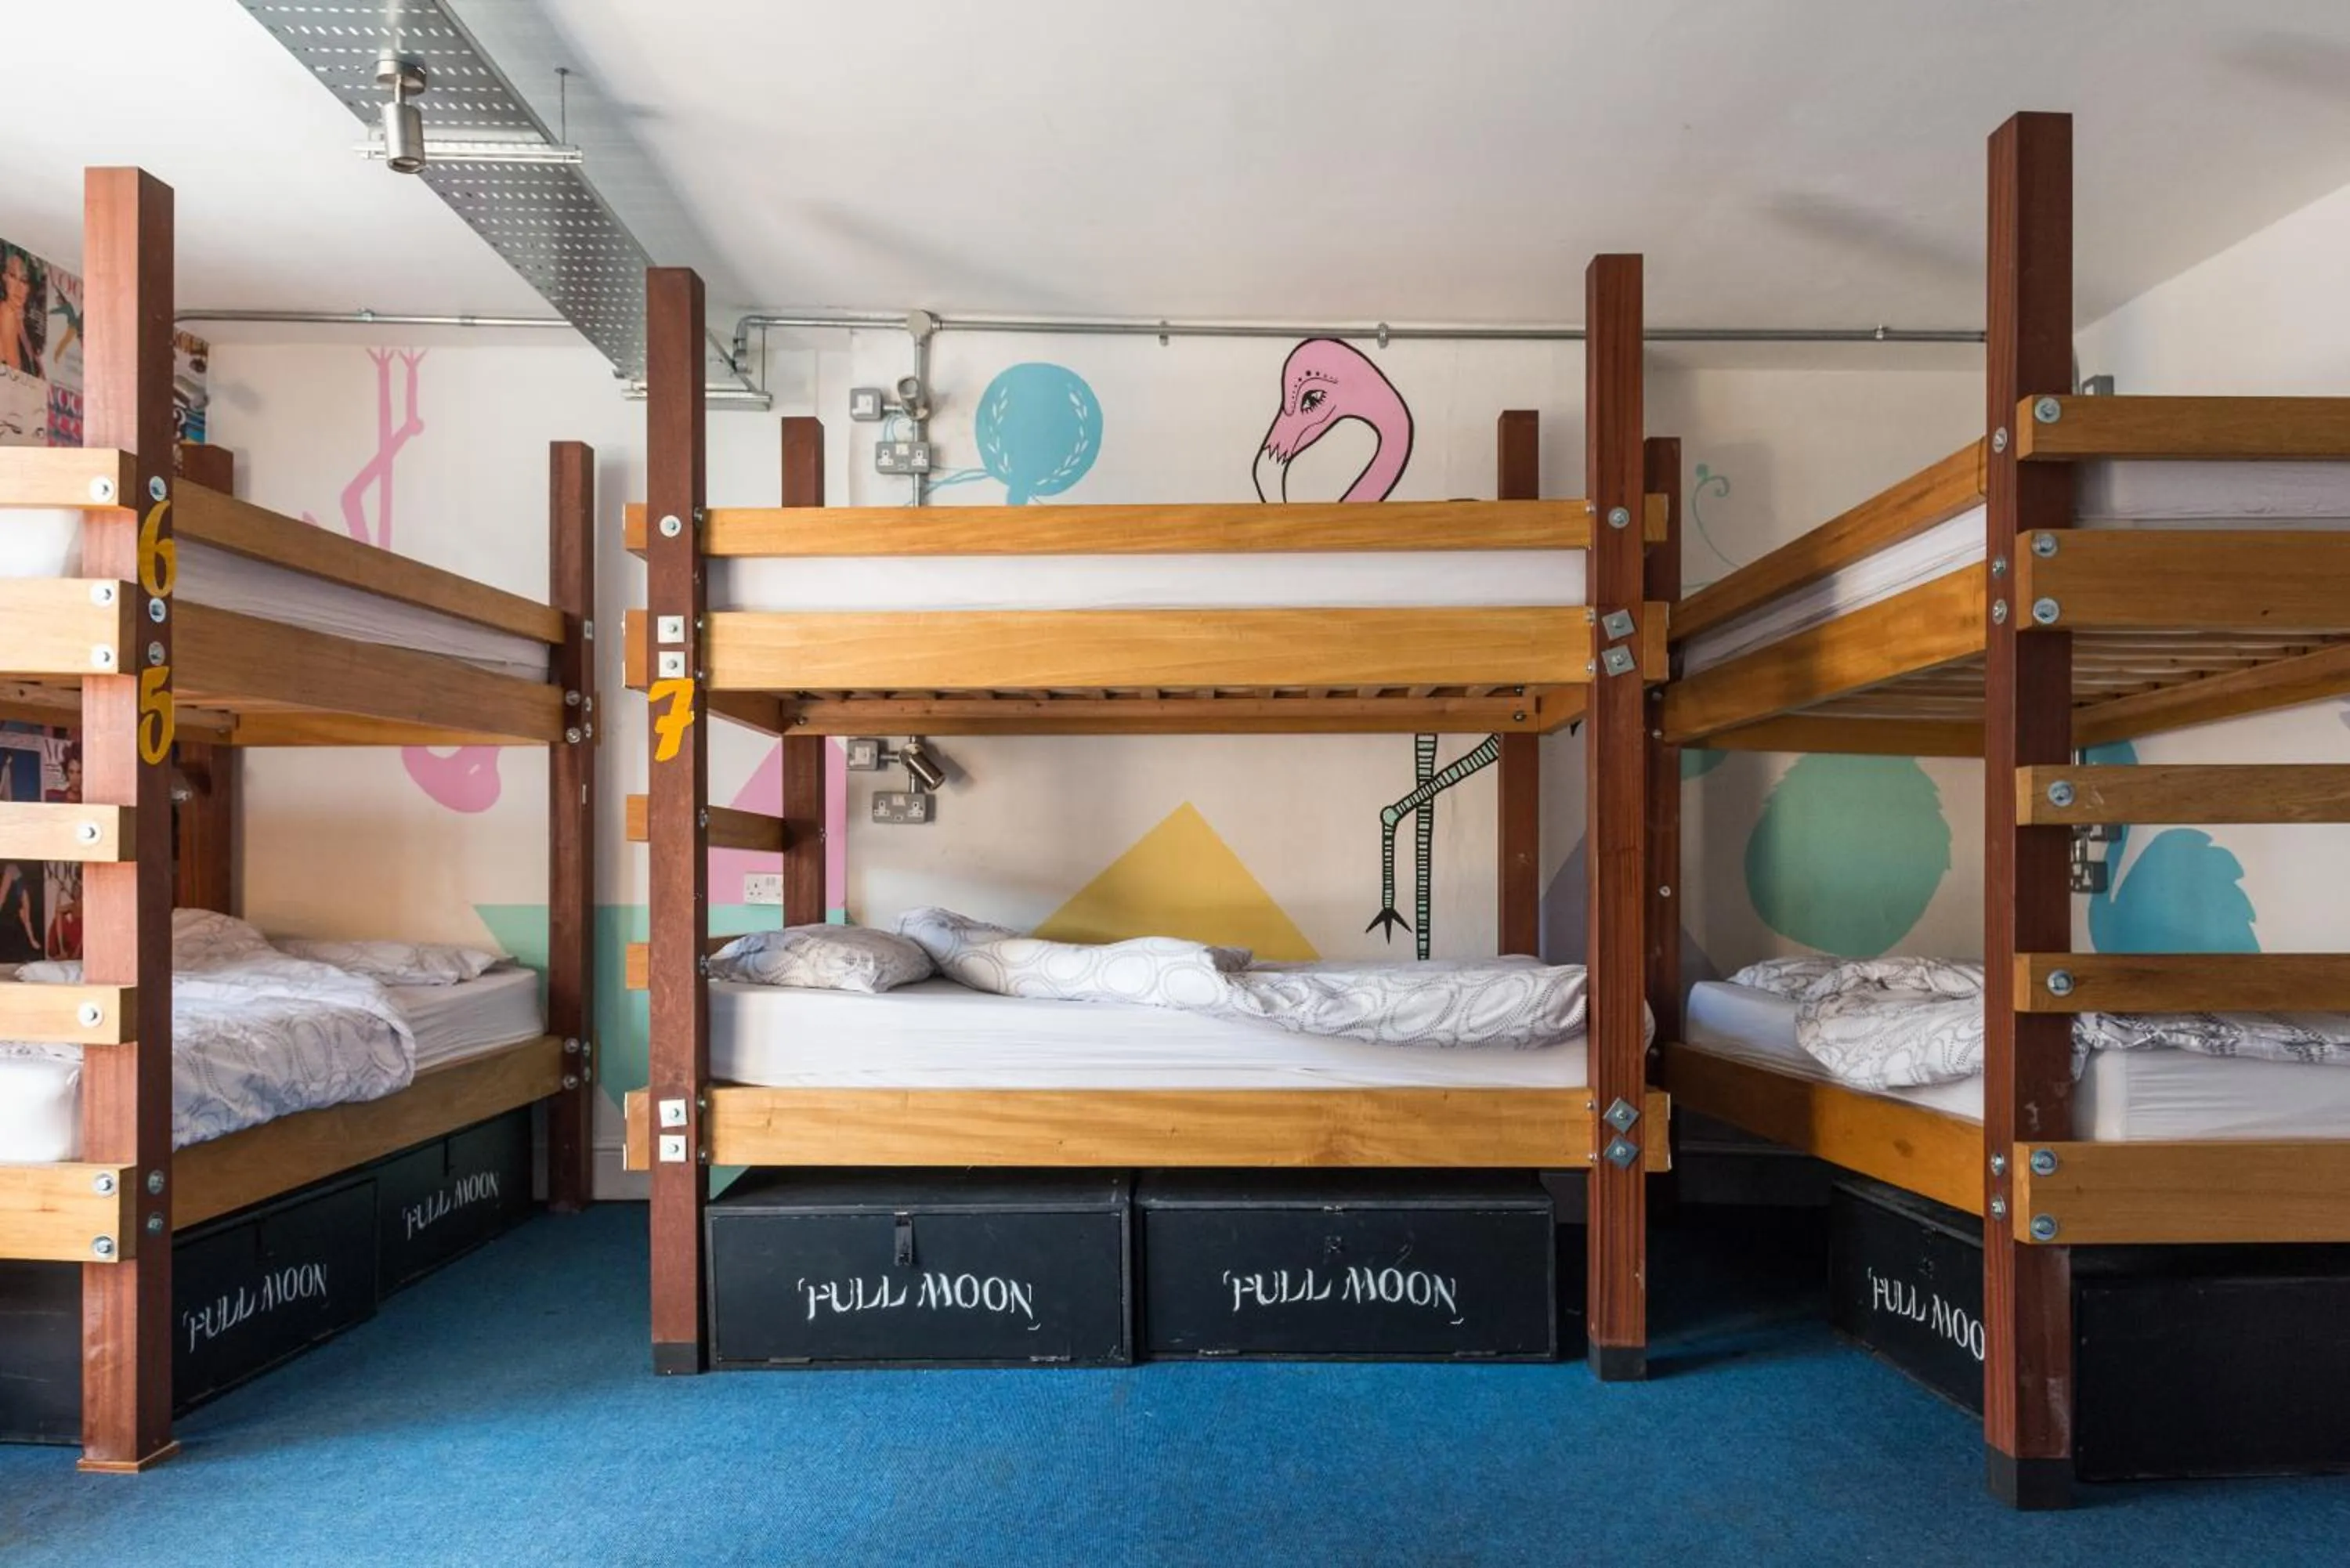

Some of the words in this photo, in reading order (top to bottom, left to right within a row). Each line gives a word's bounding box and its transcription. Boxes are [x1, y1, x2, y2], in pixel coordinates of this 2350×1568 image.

[49, 383, 83, 417] VOG
[138, 500, 177, 598] 6
[139, 666, 175, 765] 5
[649, 677, 695, 762] 7
[402, 1189, 450, 1241] FULL
[454, 1171, 501, 1209] MOON
[183, 1286, 255, 1353] FULL
[261, 1263, 329, 1311] MOON
[798, 1275, 908, 1321] FULL
[916, 1273, 1040, 1330] MOON
[1222, 1268, 1332, 1311] FULL
[1342, 1266, 1464, 1324] MOON
[1867, 1266, 1926, 1321] FULL
[1932, 1294, 1984, 1360] MOO
